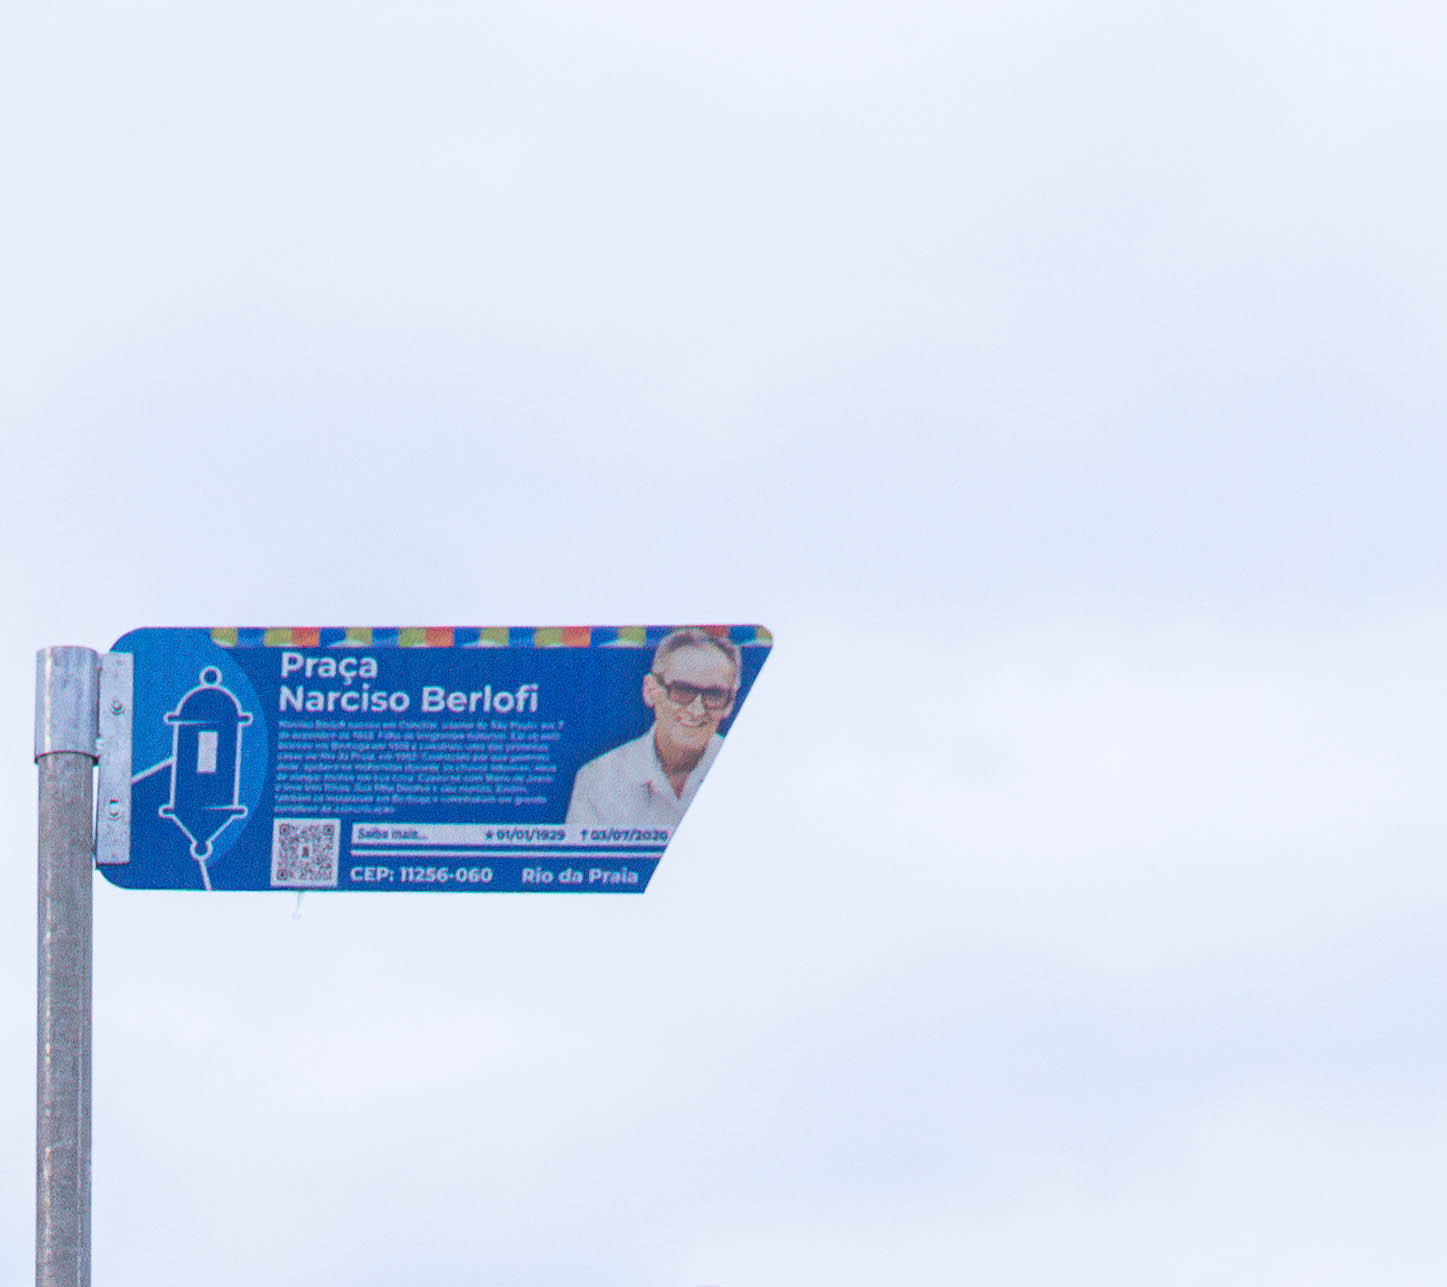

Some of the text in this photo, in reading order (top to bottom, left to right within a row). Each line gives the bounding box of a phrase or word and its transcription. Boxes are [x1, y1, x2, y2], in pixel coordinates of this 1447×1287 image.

[281, 651, 379, 686] Praça
[279, 683, 540, 714] Narciso Berlofi
[357, 828, 389, 840] Saiba
[350, 866, 640, 885] CEP: 11256-060 Rio da Praia
